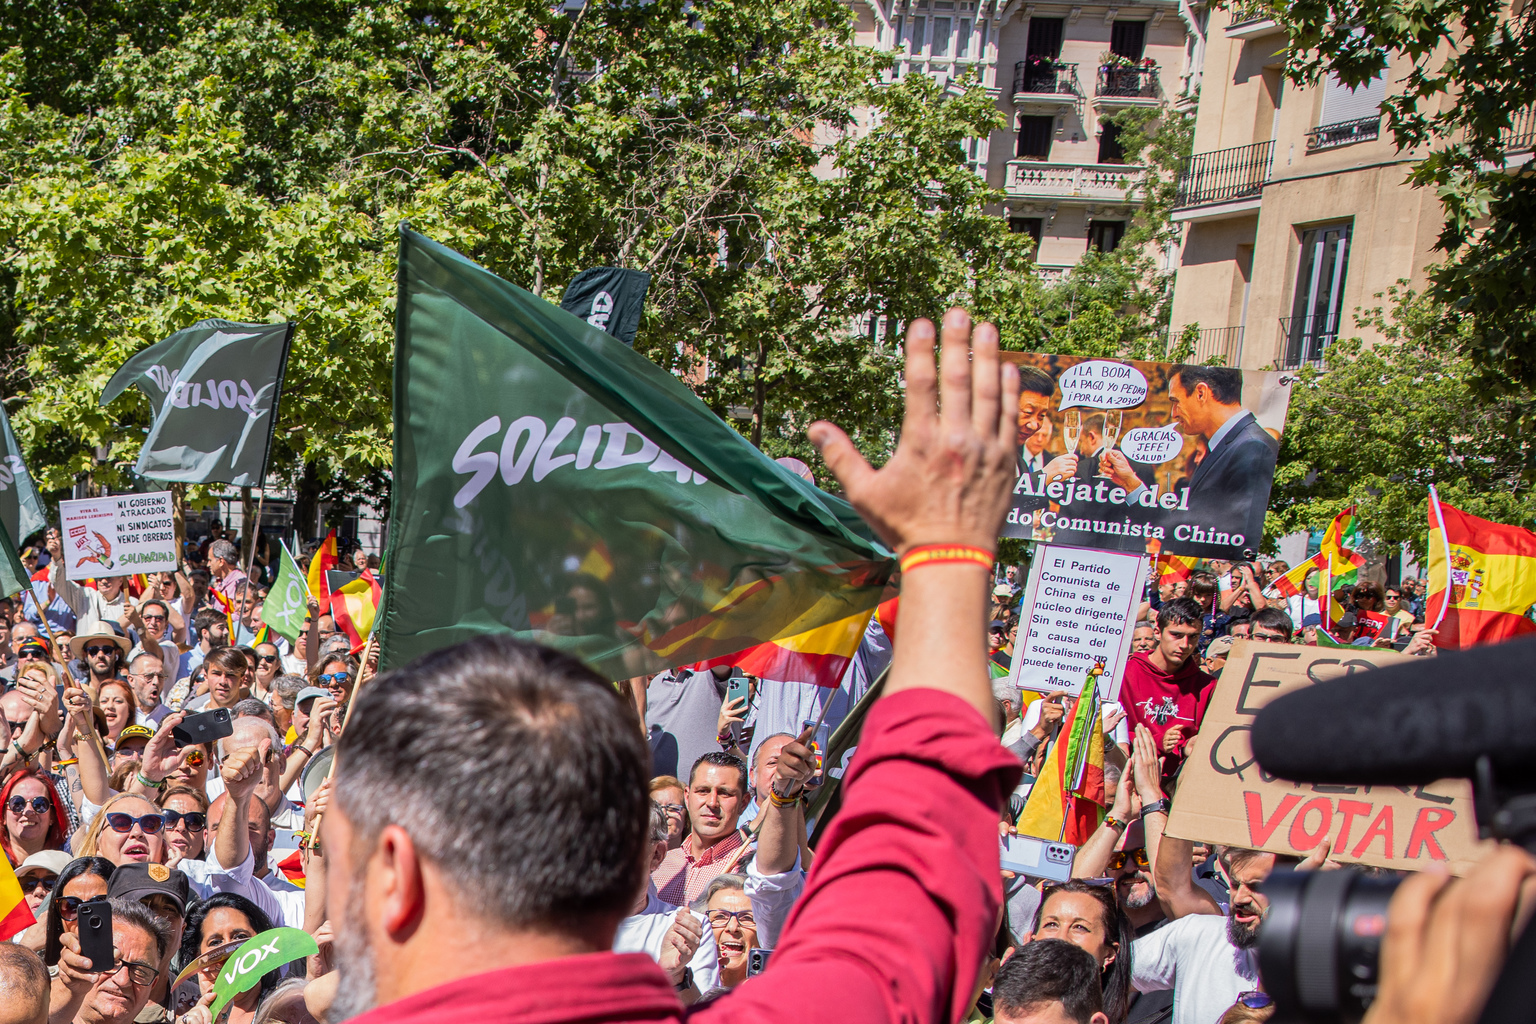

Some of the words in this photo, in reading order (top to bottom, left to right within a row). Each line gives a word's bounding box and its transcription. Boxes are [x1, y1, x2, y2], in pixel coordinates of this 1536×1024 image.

[1101, 366, 1131, 378] BODA
[1063, 379, 1077, 389] LA
[1080, 380, 1105, 391] PAGO
[1120, 383, 1146, 396] PEDRO
[1092, 394, 1103, 404] LA
[1106, 396, 1141, 406] A-2030!
[1129, 430, 1177, 442] ¡GRACIAS
[1013, 472, 1127, 505] Aléjate
[1139, 484, 1190, 511] del
[130, 497, 166, 507] GOBIERNO
[120, 507, 166, 517] ATRACADOR
[117, 524, 125, 532] NI
[128, 519, 172, 530] SINDICATOS
[1040, 511, 1165, 540] Comunista
[1173, 524, 1246, 547] Chino
[117, 534, 140, 544] VENDE
[143, 532, 173, 542] OBREROS
[119, 551, 175, 566] SOLIDARIDAD
[1053, 558, 1066, 569] El
[1071, 561, 1111, 575] Partido
[1041, 572, 1100, 589] Comunista
[1107, 581, 1121, 592] de
[1045, 587, 1076, 600] China
[1082, 594, 1095, 602] es
[1101, 595, 1112, 605] el
[1035, 600, 1072, 614] núcleo
[1075, 605, 1126, 622] dirigente.
[1032, 614, 1050, 625] Sin
[1055, 619, 1079, 630] este
[1084, 622, 1123, 636] núcleo
[1029, 629, 1039, 638] la
[1047, 633, 1080, 644] causa
[1089, 638, 1107, 648] del
[1032, 644, 1091, 660] socialismo
[1023, 658, 1054, 670] puede
[1056, 660, 1083, 674] tener
[1045, 675, 1075, 687] -Mao-
[1243, 790, 1457, 862] VOTAR
[224, 936, 280, 985] VOX
